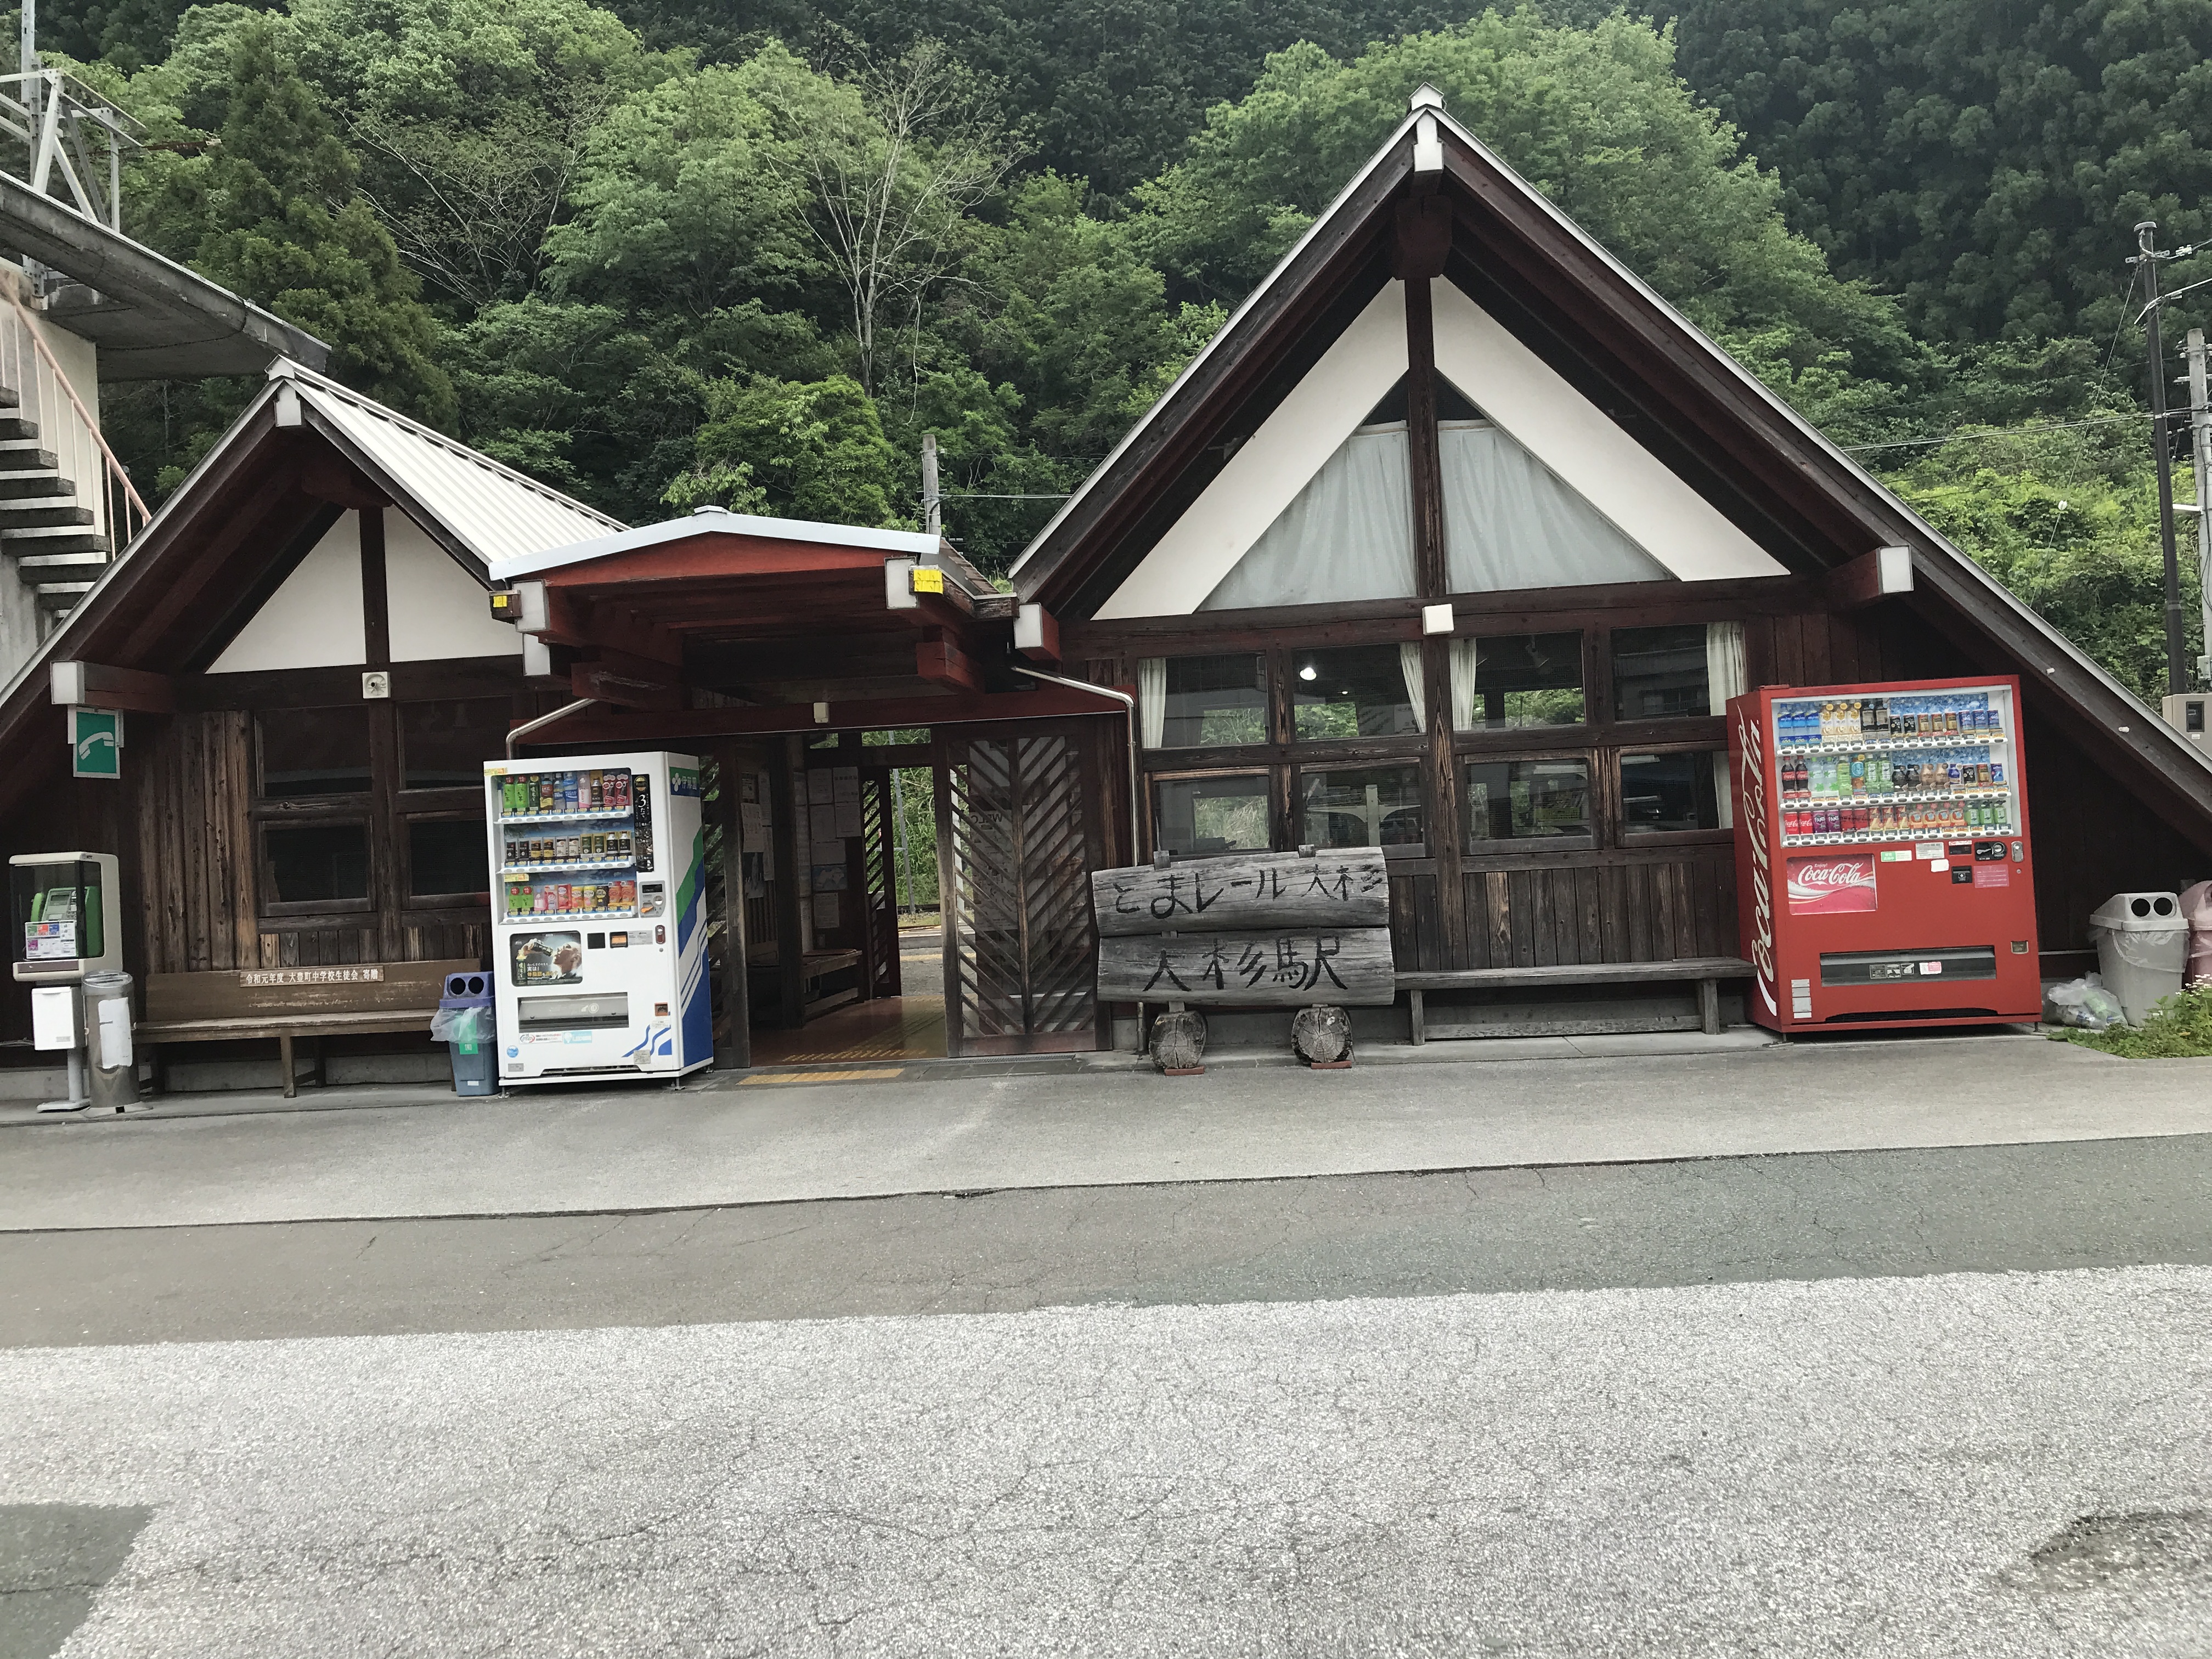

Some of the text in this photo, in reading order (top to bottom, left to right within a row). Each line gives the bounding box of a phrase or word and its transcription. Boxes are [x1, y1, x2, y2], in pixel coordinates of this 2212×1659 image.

[1736, 702, 1776, 1017] Coca-Cola
[1797, 862, 1864, 886] Coca-Cola
[245, 968, 379, 985] 令和元年度 大豊町中学校生徒会 寄贈
[1142, 935, 1348, 992] 大杉駅
